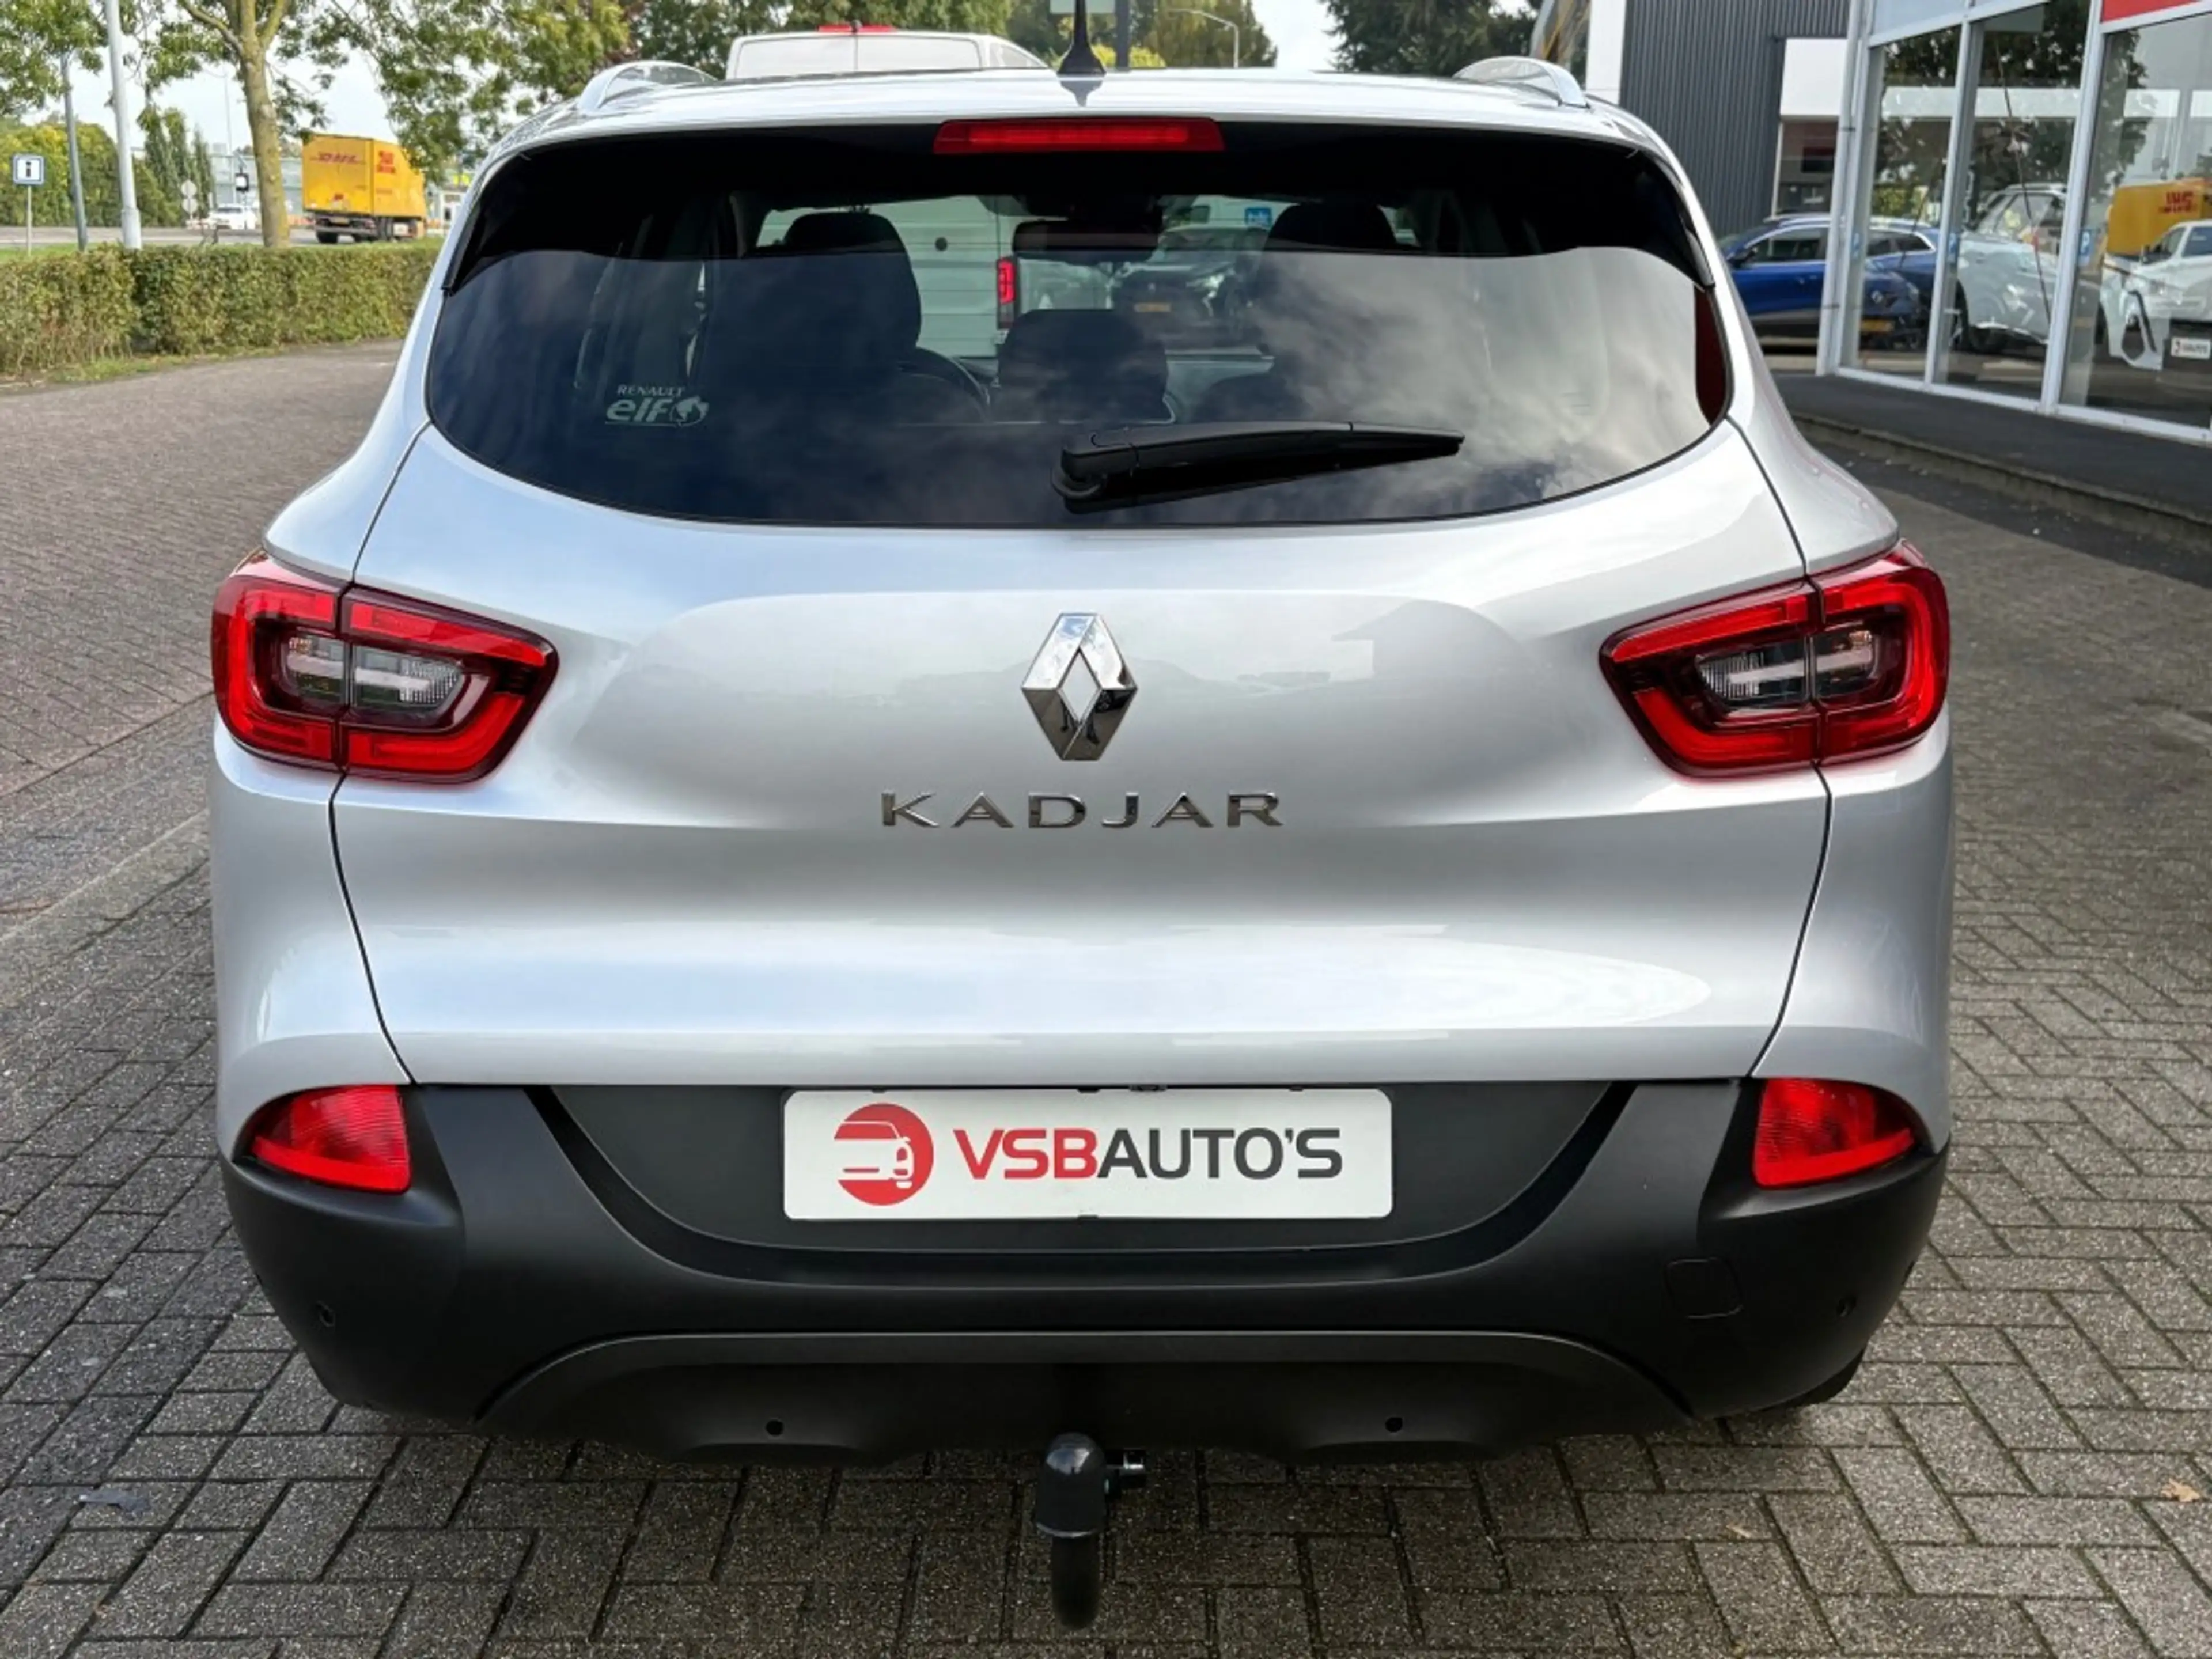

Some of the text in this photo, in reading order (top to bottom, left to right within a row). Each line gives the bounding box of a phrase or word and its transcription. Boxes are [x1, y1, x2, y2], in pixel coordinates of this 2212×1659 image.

[617, 384, 685, 397] RENAULT
[881, 791, 1284, 828] KADJAR
[954, 1127, 1343, 1179] VSBAUTO'S
